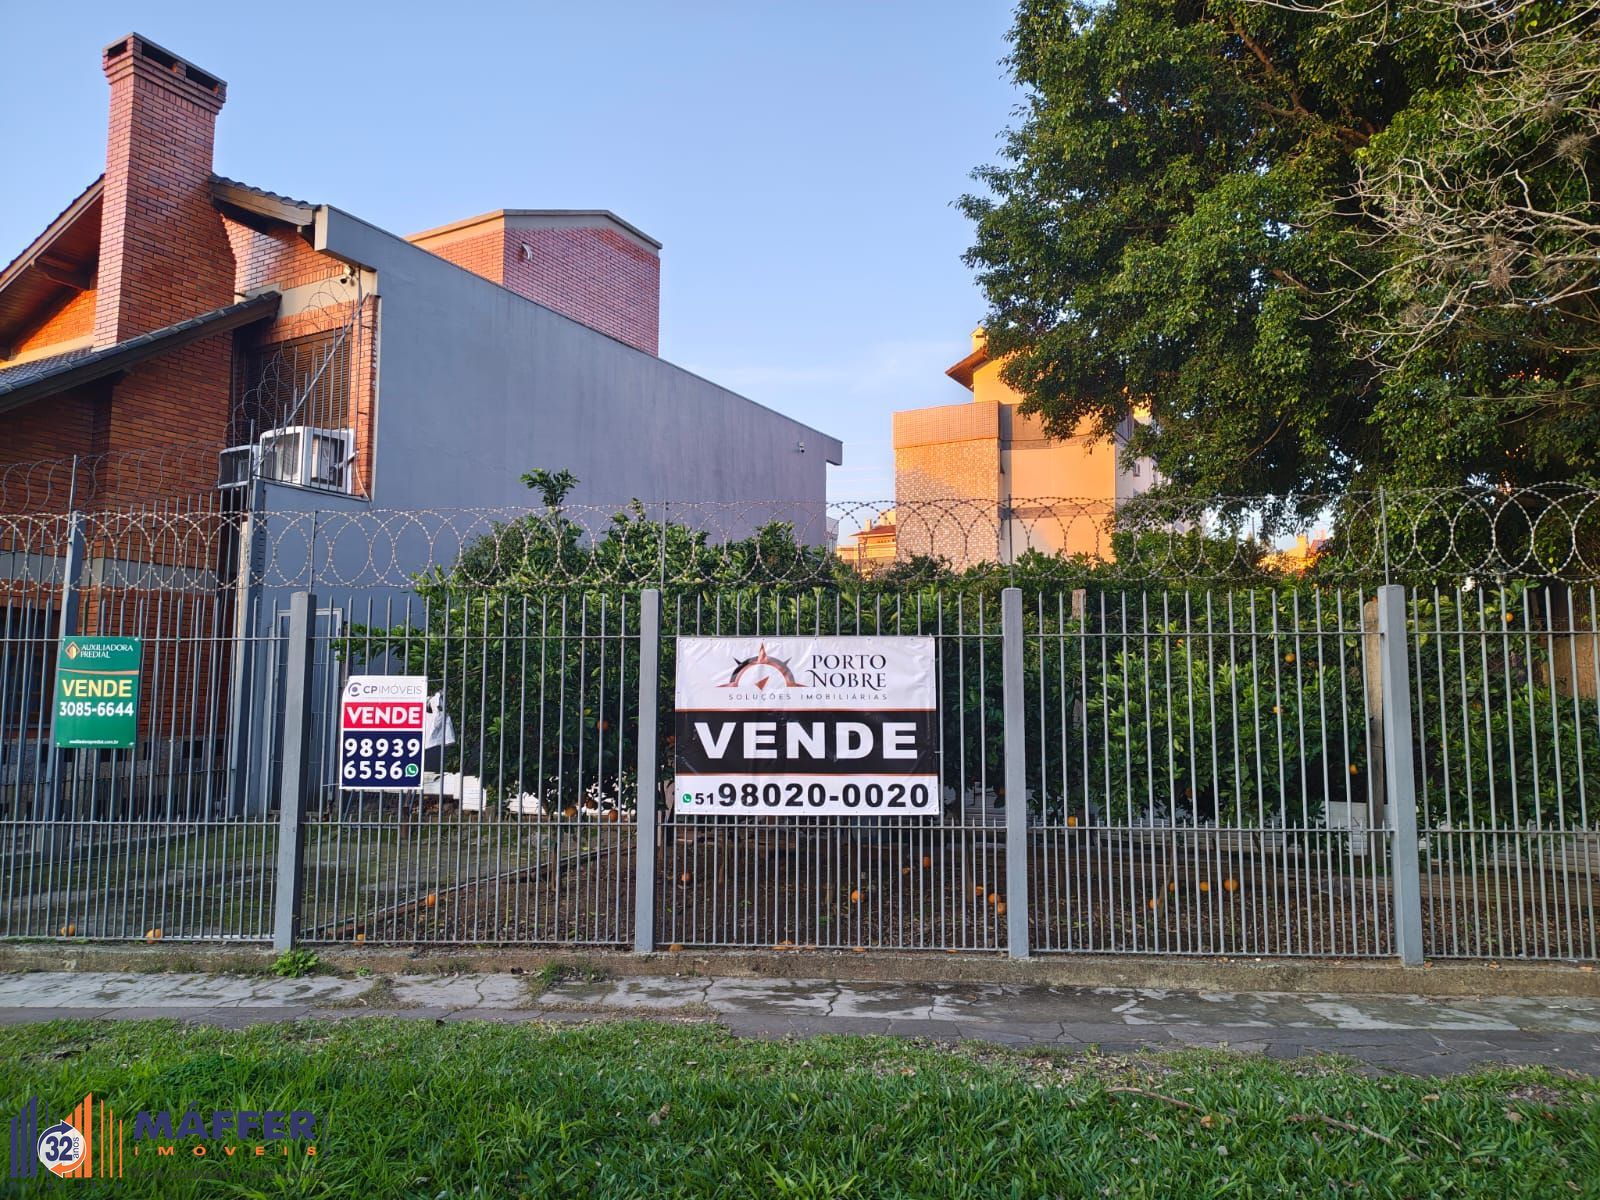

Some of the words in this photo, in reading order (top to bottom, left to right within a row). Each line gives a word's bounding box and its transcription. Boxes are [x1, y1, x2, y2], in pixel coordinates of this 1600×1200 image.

[81, 643, 133, 651] AUXILIADORA
[812, 654, 887, 670] PORTO
[62, 679, 132, 697] VENDE
[805, 669, 887, 691] NOBRE
[363, 685, 377, 694] CP
[728, 692, 792, 701] SOLUÇÕES
[800, 692, 888, 701] IMOBILIÁRIAS
[59, 701, 134, 717] 3085-6644
[346, 706, 421, 725] VENDE
[344, 738, 420, 758] 98939
[694, 721, 918, 760] VENDE
[343, 760, 403, 780] 6556
[694, 792, 714, 806] 51
[718, 782, 930, 808] 98020-0020
